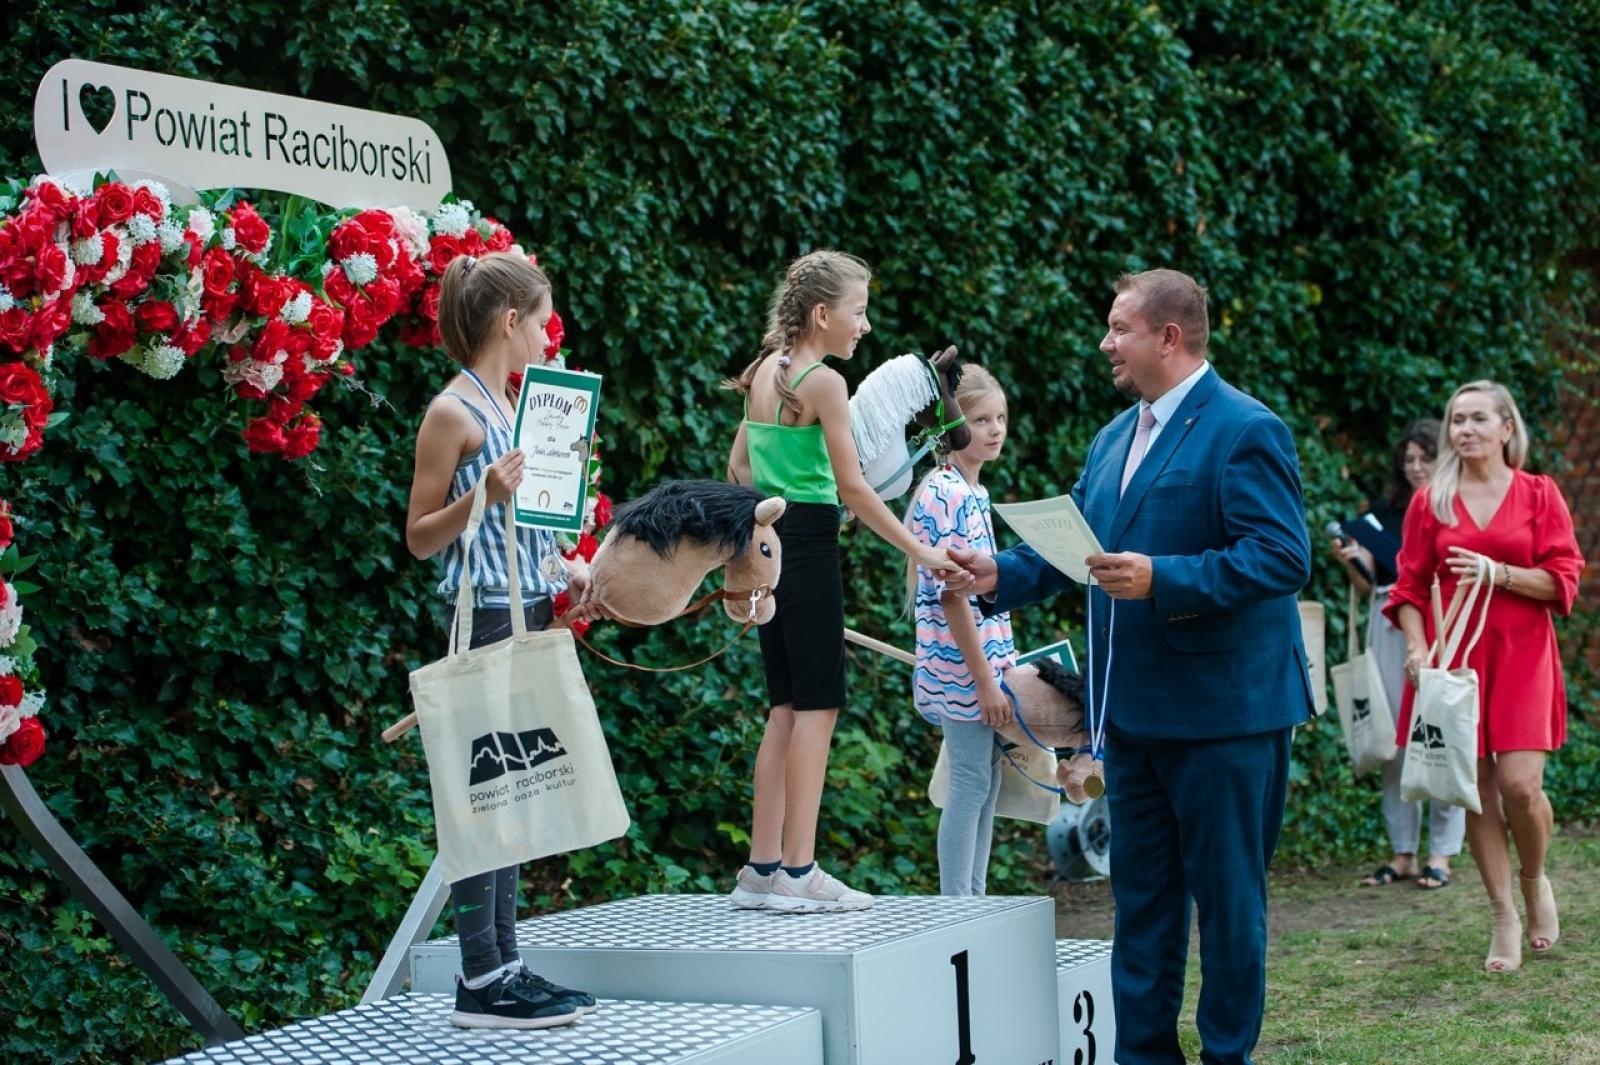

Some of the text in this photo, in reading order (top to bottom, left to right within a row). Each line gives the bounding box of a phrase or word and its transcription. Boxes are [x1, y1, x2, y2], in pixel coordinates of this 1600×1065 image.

[62, 79, 431, 184] I Powiat Raciborski
[529, 393, 572, 416] DYPLOM
[470, 763, 574, 804] powiat raciborski
[472, 778, 576, 814] zielona oaza kultur
[950, 950, 976, 1065] 1
[1073, 990, 1097, 1065] 3
